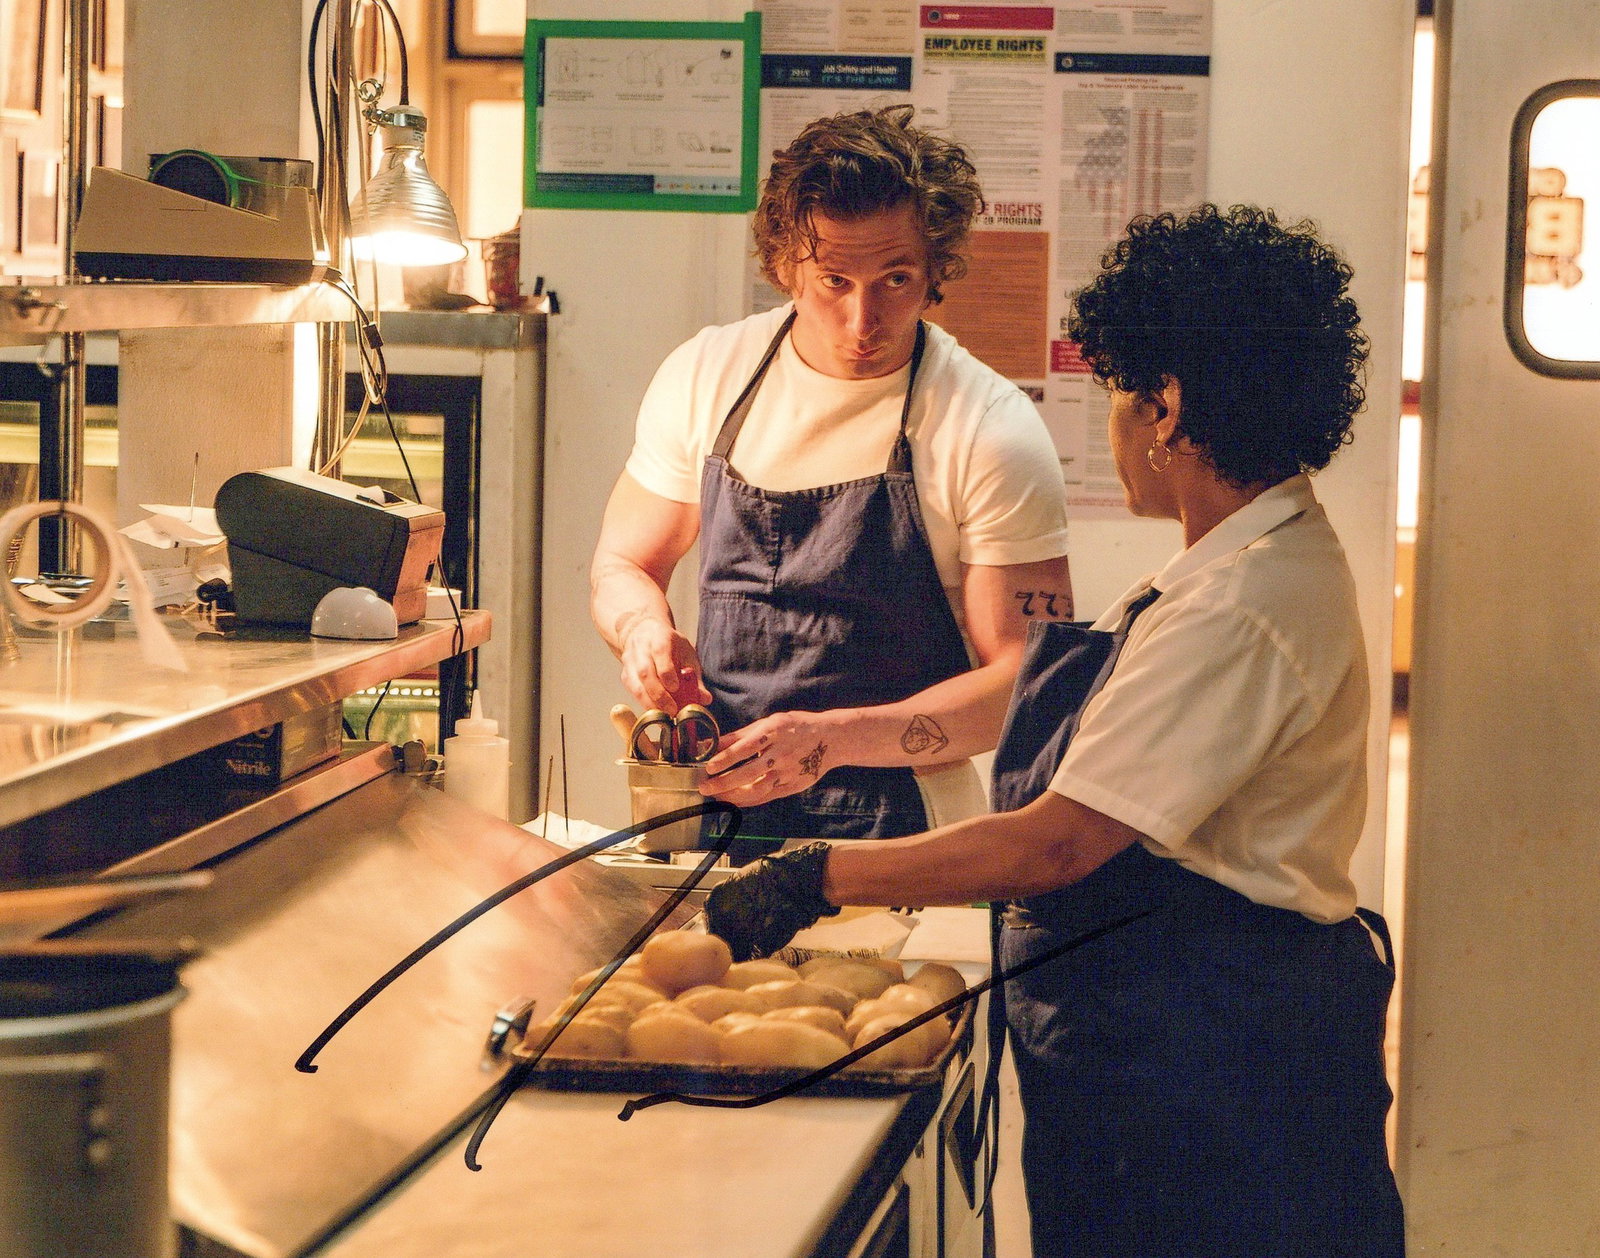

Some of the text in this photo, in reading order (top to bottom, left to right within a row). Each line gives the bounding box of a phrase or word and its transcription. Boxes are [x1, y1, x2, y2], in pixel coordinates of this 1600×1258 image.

[924, 38, 1044, 52] EMPLOYEE RIGHTS
[822, 65, 897, 76] Job Safety and Health
[994, 203, 1042, 217] RIGHTS
[997, 216, 1041, 225] PROGRAM
[225, 758, 271, 777] Nitrile
